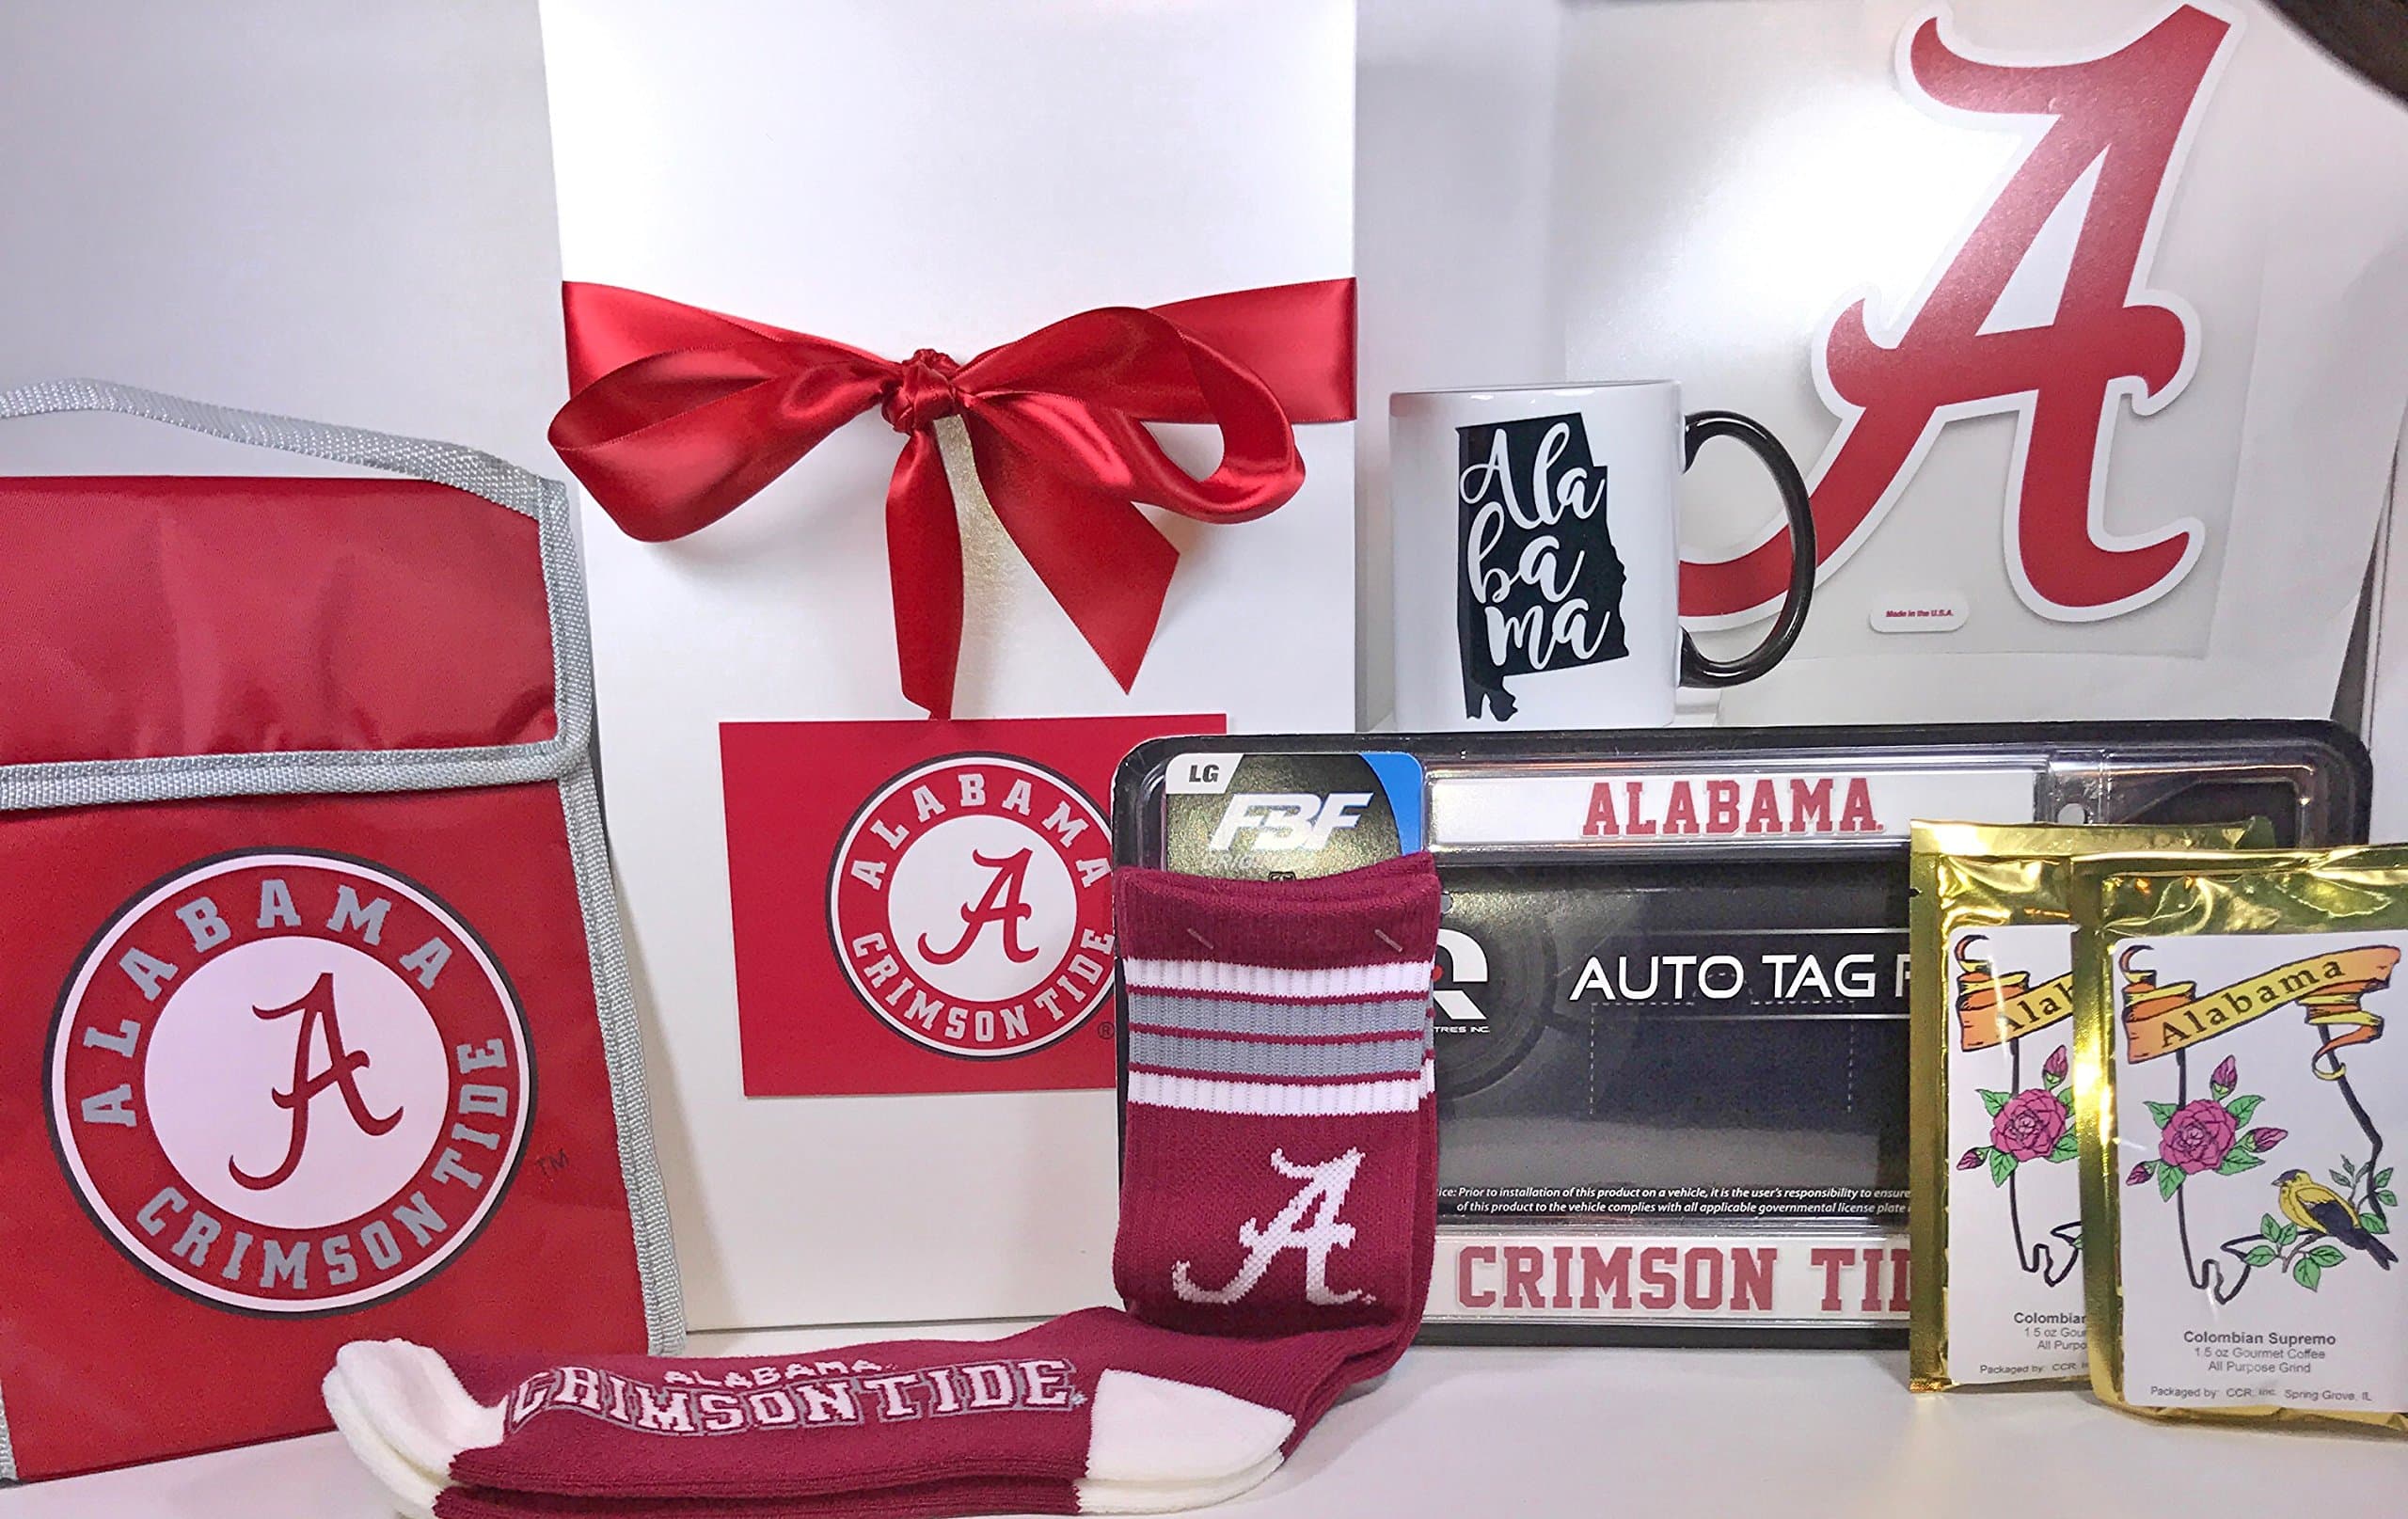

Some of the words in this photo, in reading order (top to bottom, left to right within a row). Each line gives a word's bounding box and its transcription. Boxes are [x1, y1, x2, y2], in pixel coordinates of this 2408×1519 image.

[1460, 422, 1606, 530] Ala
[1467, 501, 1585, 604] ba
[1484, 599, 1610, 670] ma
[1189, 765, 1219, 783] LG
[851, 773, 1114, 889] ALABAMA
[1582, 777, 1879, 836] ALABAMA
[917, 847, 1039, 965] A
[82, 879, 453, 1127] ALABAMA
[853, 932, 1030, 1042] CRIMSON
[1034, 928, 1115, 1021] TIDE
[1569, 954, 1745, 1001] AUTO
[1762, 953, 1877, 998] TAG
[2162, 960, 2346, 1048] Alabama
[229, 973, 404, 1191] A
[136, 1186, 449, 1290] CRIMSON
[432, 1038, 509, 1191] TIDE
[1459, 1187, 1485, 1197] Prior
[1486, 1188, 1498, 1197] to
[1499, 1187, 1560, 1197] installation
[1562, 1187, 1576, 1197] of
[1576, 1187, 1595, 1197] this
[1597, 1187, 1640, 1199] product
[1641, 1189, 1656, 1197] on
[1658, 1189, 1666, 1197] a
[1668, 1187, 1708, 1198] vehicle,
[1711, 1187, 1719, 1197] it
[1720, 1187, 1730, 1197] is
[1732, 1187, 1750, 1197] the
[1751, 1187, 1782, 1197] user's
[1784, 1187, 1859, 1200] responsibility
[1860, 1189, 1872, 1197] to
[1874, 1190, 1911, 1198] ensure
[1457, 1201, 1469, 1211] of
[1470, 1201, 1489, 1211] this
[1491, 1202, 1534, 1213] product
[1535, 1203, 1547, 1212] to
[1549, 1202, 1566, 1212] the
[1568, 1202, 1607, 1212] vehicle
[1608, 1202, 1656, 1214] complies
[1658, 1202, 1682, 1212] with
[1684, 1202, 1698, 1212] all
[1700, 1202, 1757, 1214] applicable
[1758, 1203, 1837, 1214] governmental
[1837, 1203, 1876, 1212] license
[1877, 1203, 1906, 1214] plate
[1457, 1245, 1778, 1311] CRIMSON
[2036, 1340, 2052, 1351] All
[2044, 1330, 2057, 1338] oz
[2183, 1331, 2263, 1344] Colombian
[2268, 1332, 2337, 1348] Supremo
[2232, 1347, 2284, 1359] Gourmet
[2287, 1348, 2325, 1359] Coffee
[664, 1359, 882, 1388] ALABAMA
[862, 1358, 1073, 1420] TIDE
[1980, 1364, 2029, 1374] Packaged
[2150, 1386, 2201, 1399] Packaged
[2284, 1389, 2319, 1401] Spring
[2208, 1362, 2223, 1372] All
[2226, 1361, 2275, 1375] Purpose
[2279, 1362, 2311, 1373] Grind
